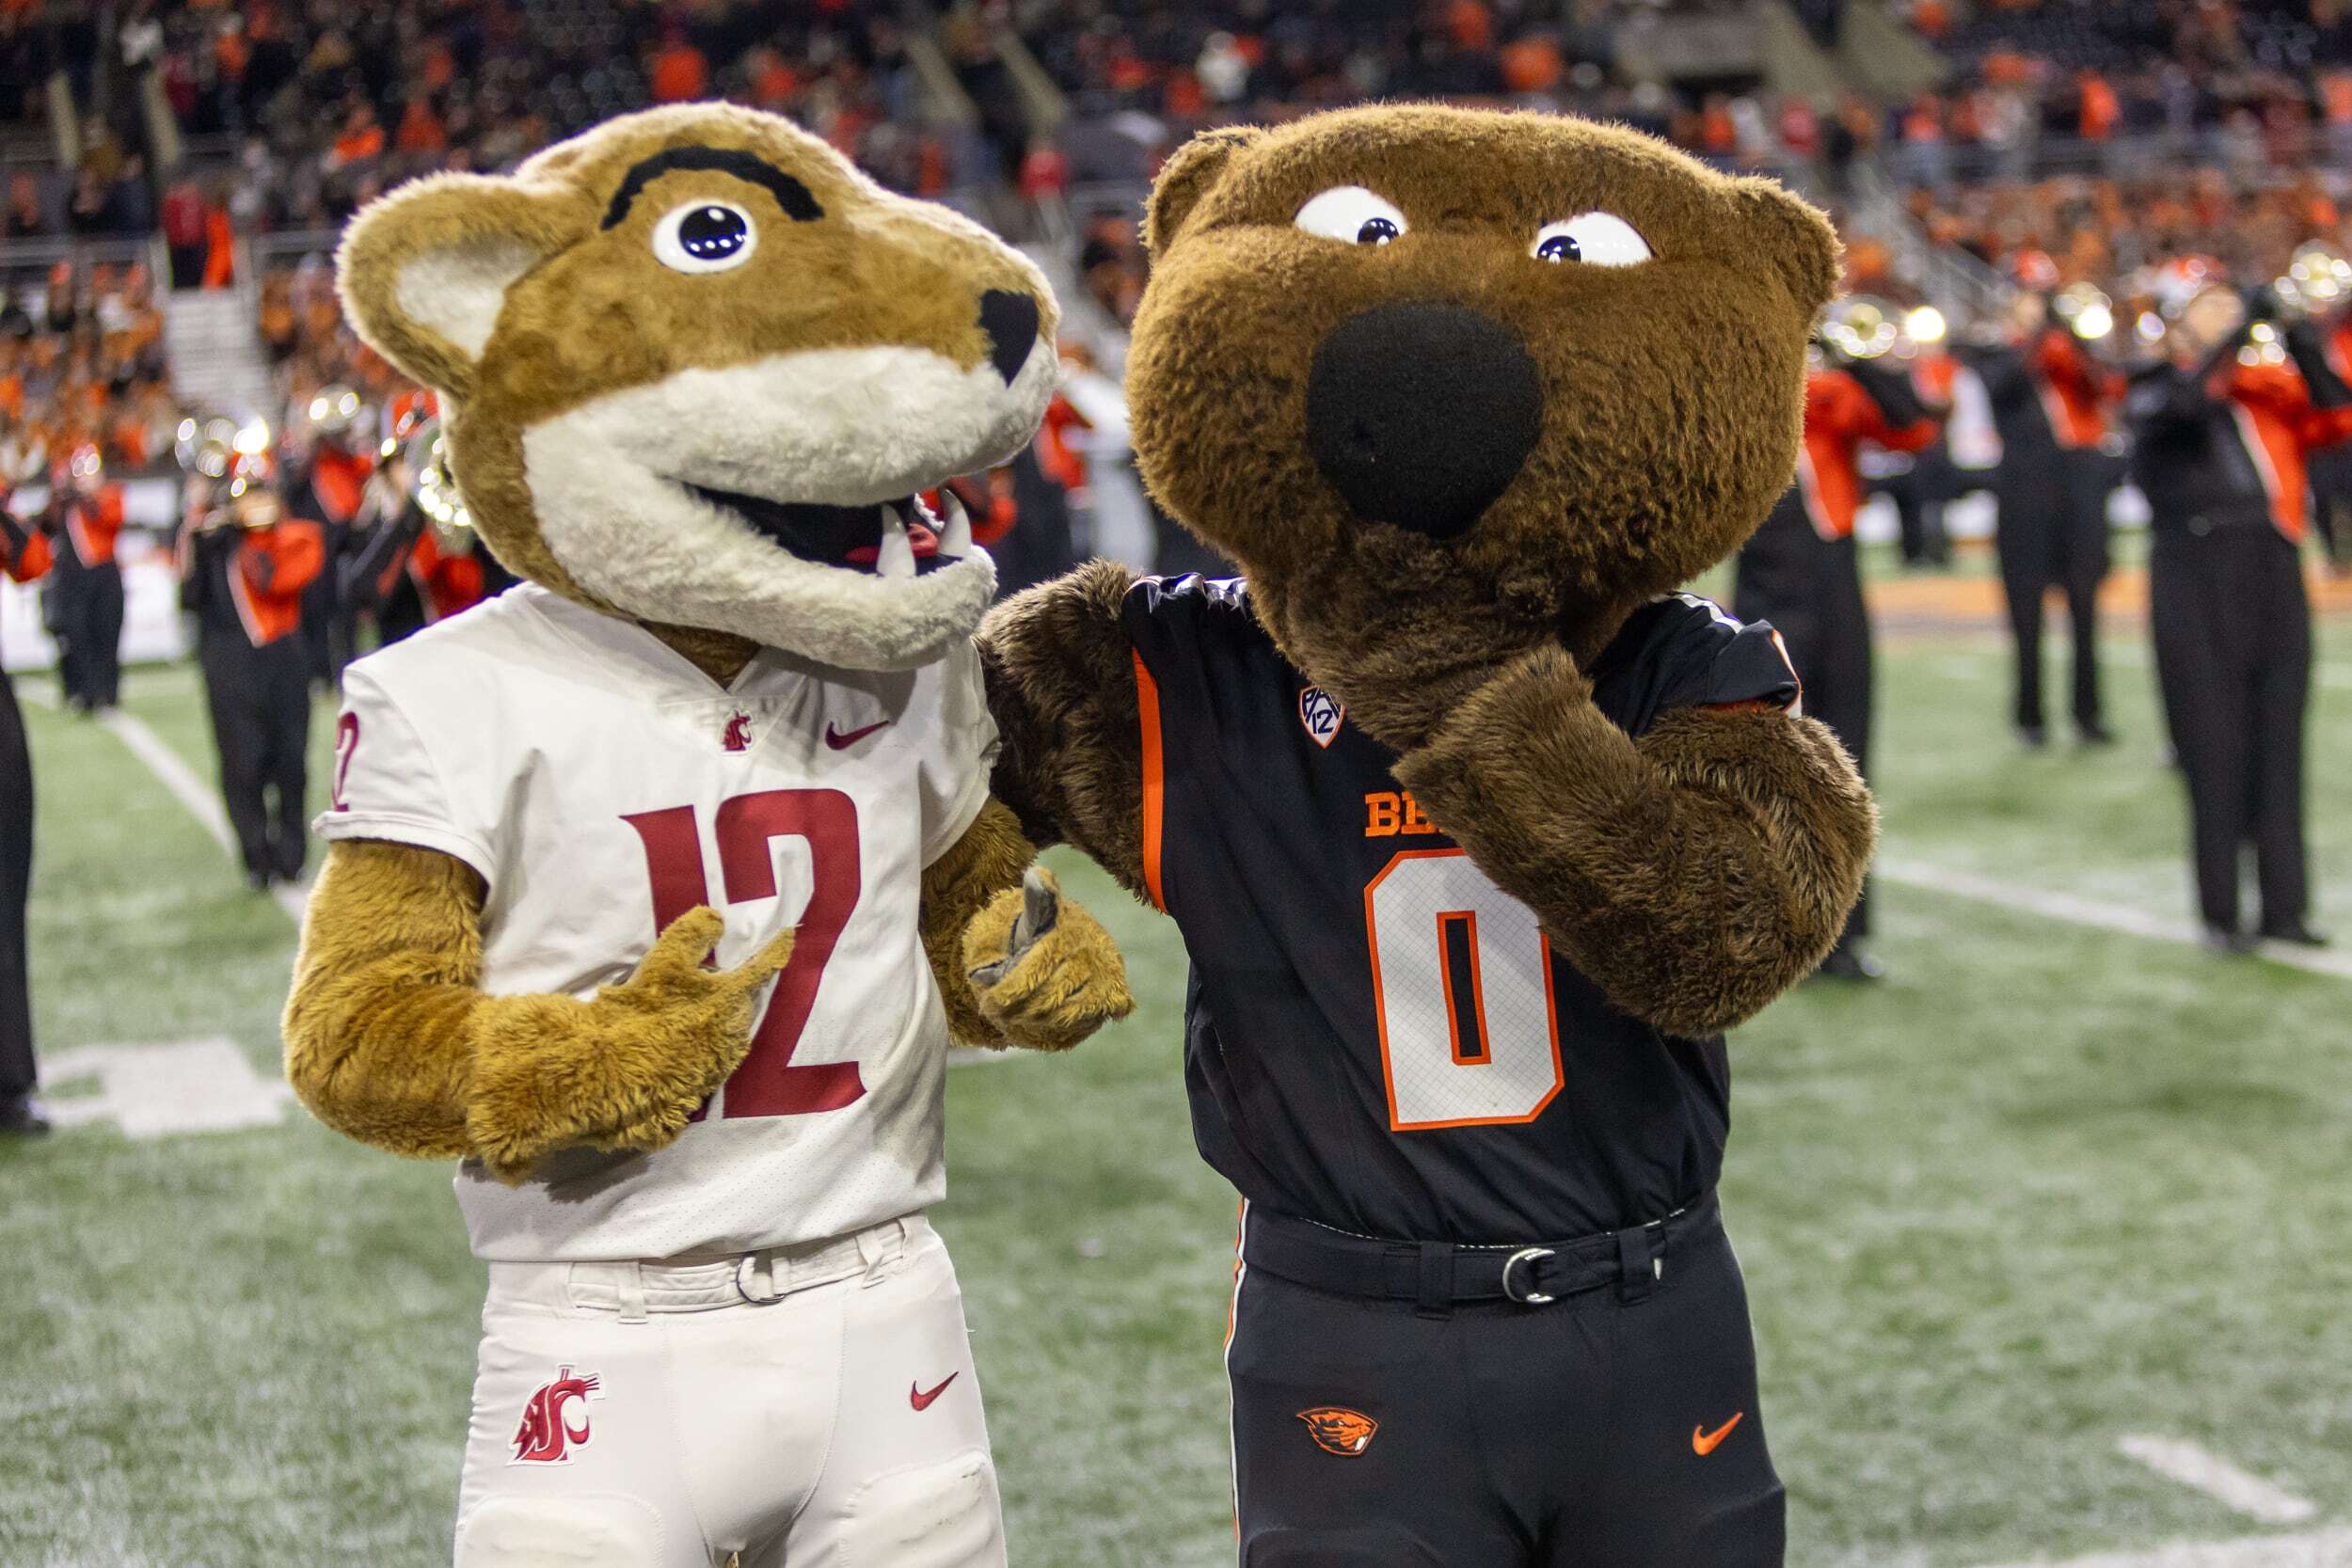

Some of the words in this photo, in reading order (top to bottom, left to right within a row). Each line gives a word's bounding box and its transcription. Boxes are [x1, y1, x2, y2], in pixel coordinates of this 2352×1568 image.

[1302, 689, 1341, 722] PA
[1312, 709, 1334, 735] 12
[1364, 791, 1446, 837] BE
[1364, 847, 1565, 1132] 0
